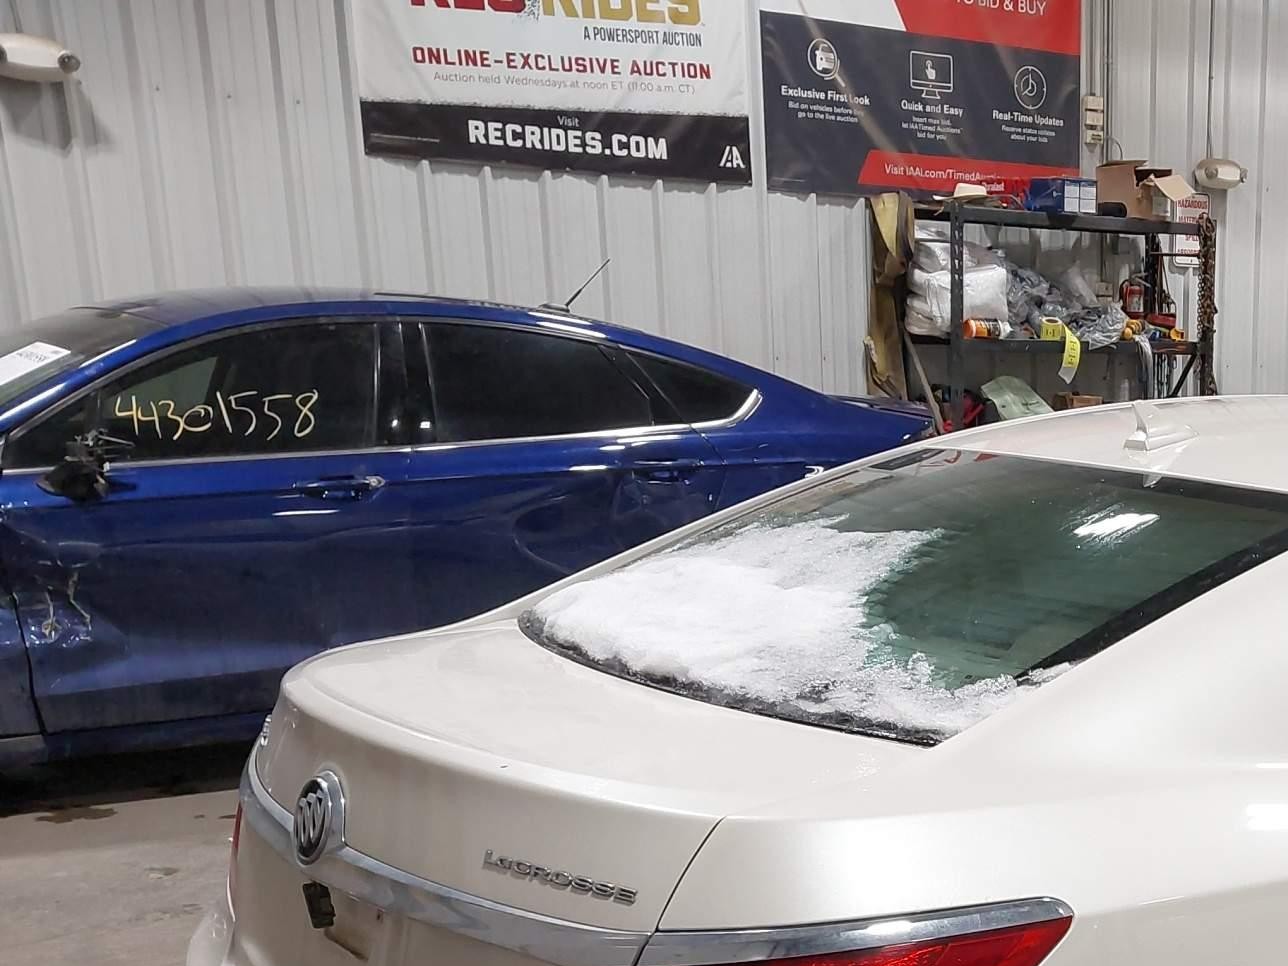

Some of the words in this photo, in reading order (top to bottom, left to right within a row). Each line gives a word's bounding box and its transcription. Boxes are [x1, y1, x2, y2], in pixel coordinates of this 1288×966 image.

[1018, 0, 1047, 16] BUY
[583, 26, 591, 41] A
[593, 26, 660, 44] POWERSPORT
[662, 31, 702, 47] AUCTION
[412, 46, 622, 75] ONLINE-EXCLUSIVE
[629, 59, 712, 80] AUCTION
[433, 71, 475, 83] Auction
[478, 74, 501, 84] held
[503, 75, 568, 89] Wednesdays
[569, 79, 579, 89] at
[583, 82, 608, 90] noon
[611, 81, 624, 90] ET
[678, 84, 695, 95] CT)
[781, 85, 826, 99] Exclusive
[827, 90, 848, 103] First
[849, 93, 870, 106] Look
[901, 99, 924, 113] Quick
[925, 103, 941, 114] and
[943, 104, 964, 118] Easy
[992, 109, 1033, 124] Real-Time
[1034, 114, 1064, 127] Updates
[557, 115, 579, 128] Visit
[467, 119, 668, 160] RECRIDES.COM
[884, 162, 904, 176] Visit
[113, 389, 319, 441] 44301558
